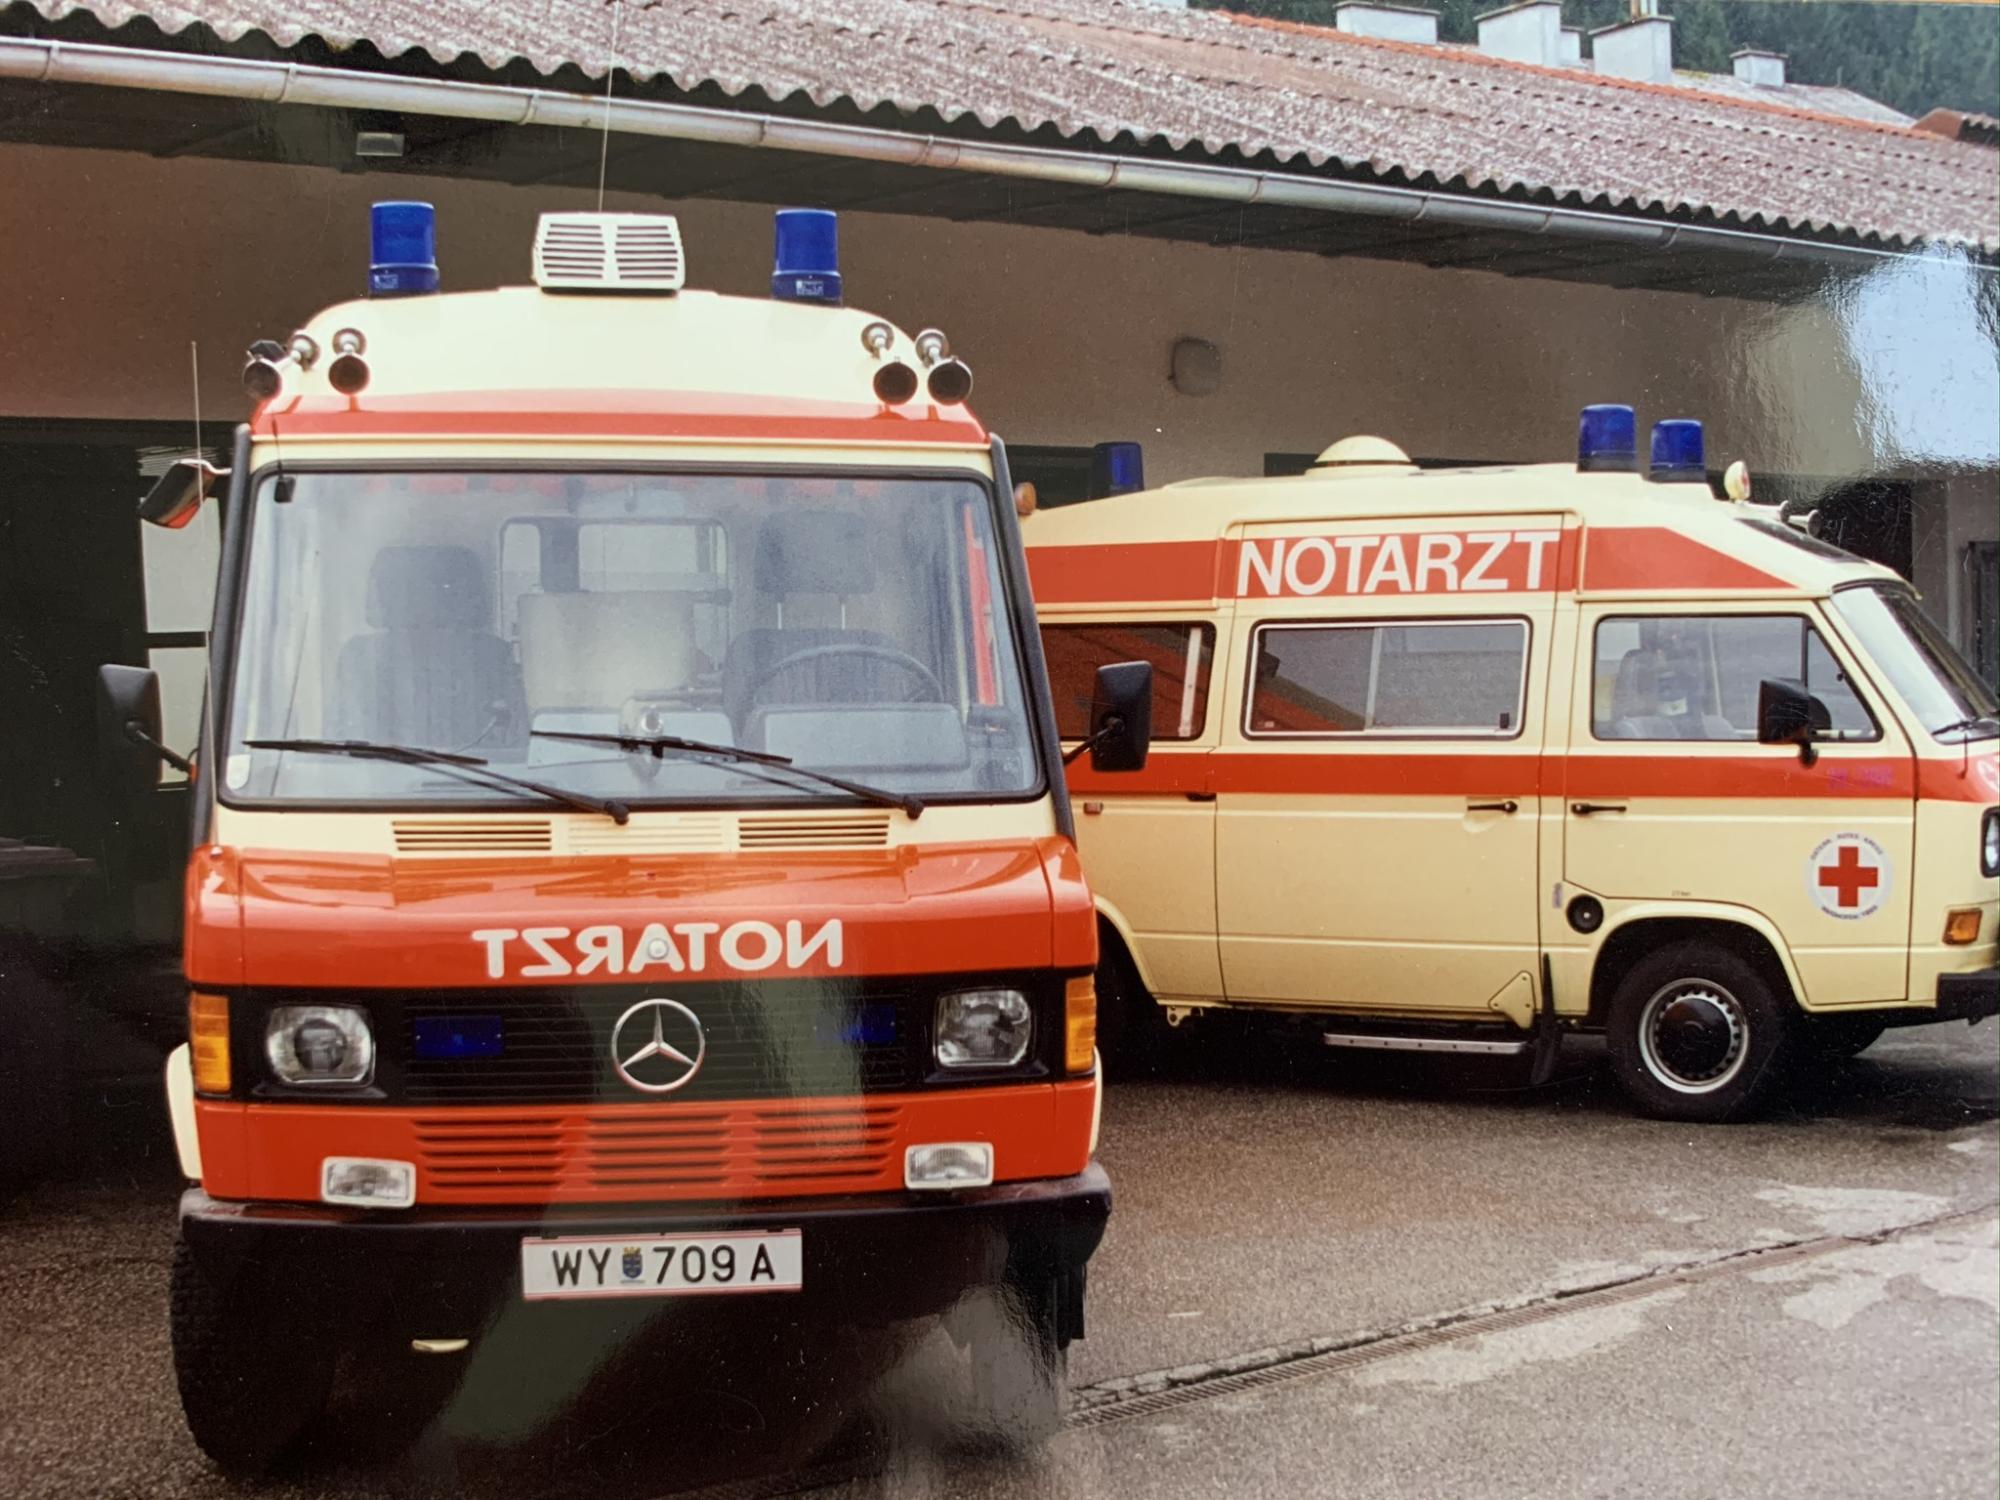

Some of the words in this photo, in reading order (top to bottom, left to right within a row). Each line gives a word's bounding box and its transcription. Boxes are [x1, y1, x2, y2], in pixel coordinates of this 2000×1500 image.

[1236, 531, 1561, 597] NOTARZT
[551, 1247, 612, 1287] WY
[652, 1244, 736, 1285] 709
[750, 1242, 776, 1282] A
